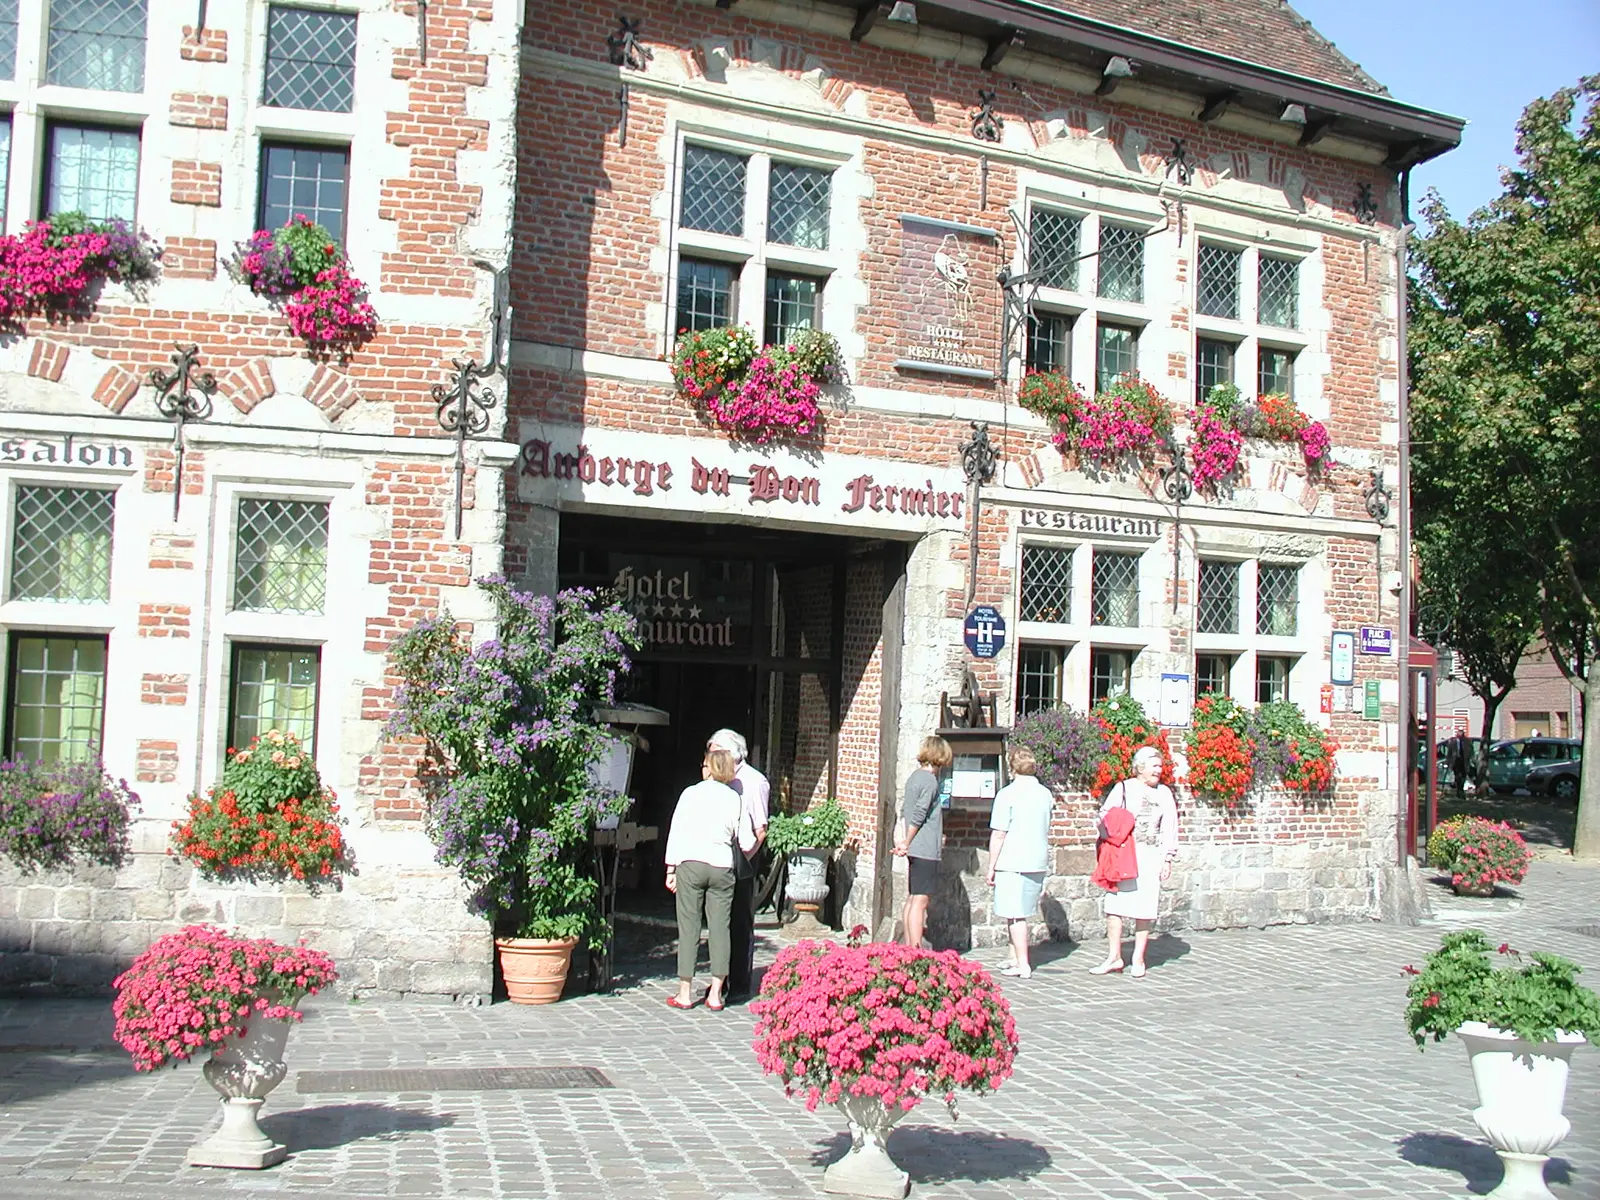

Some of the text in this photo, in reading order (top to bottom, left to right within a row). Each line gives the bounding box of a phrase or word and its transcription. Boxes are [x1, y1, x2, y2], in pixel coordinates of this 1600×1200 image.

[907, 345, 984, 365] RESTAURANT
[1, 434, 133, 467] salon
[521, 438, 965, 520] Auberge du Bon Fermier
[1020, 508, 1163, 536] restaurant
[977, 622, 993, 643] H
[1368, 629, 1385, 639] PLACE
